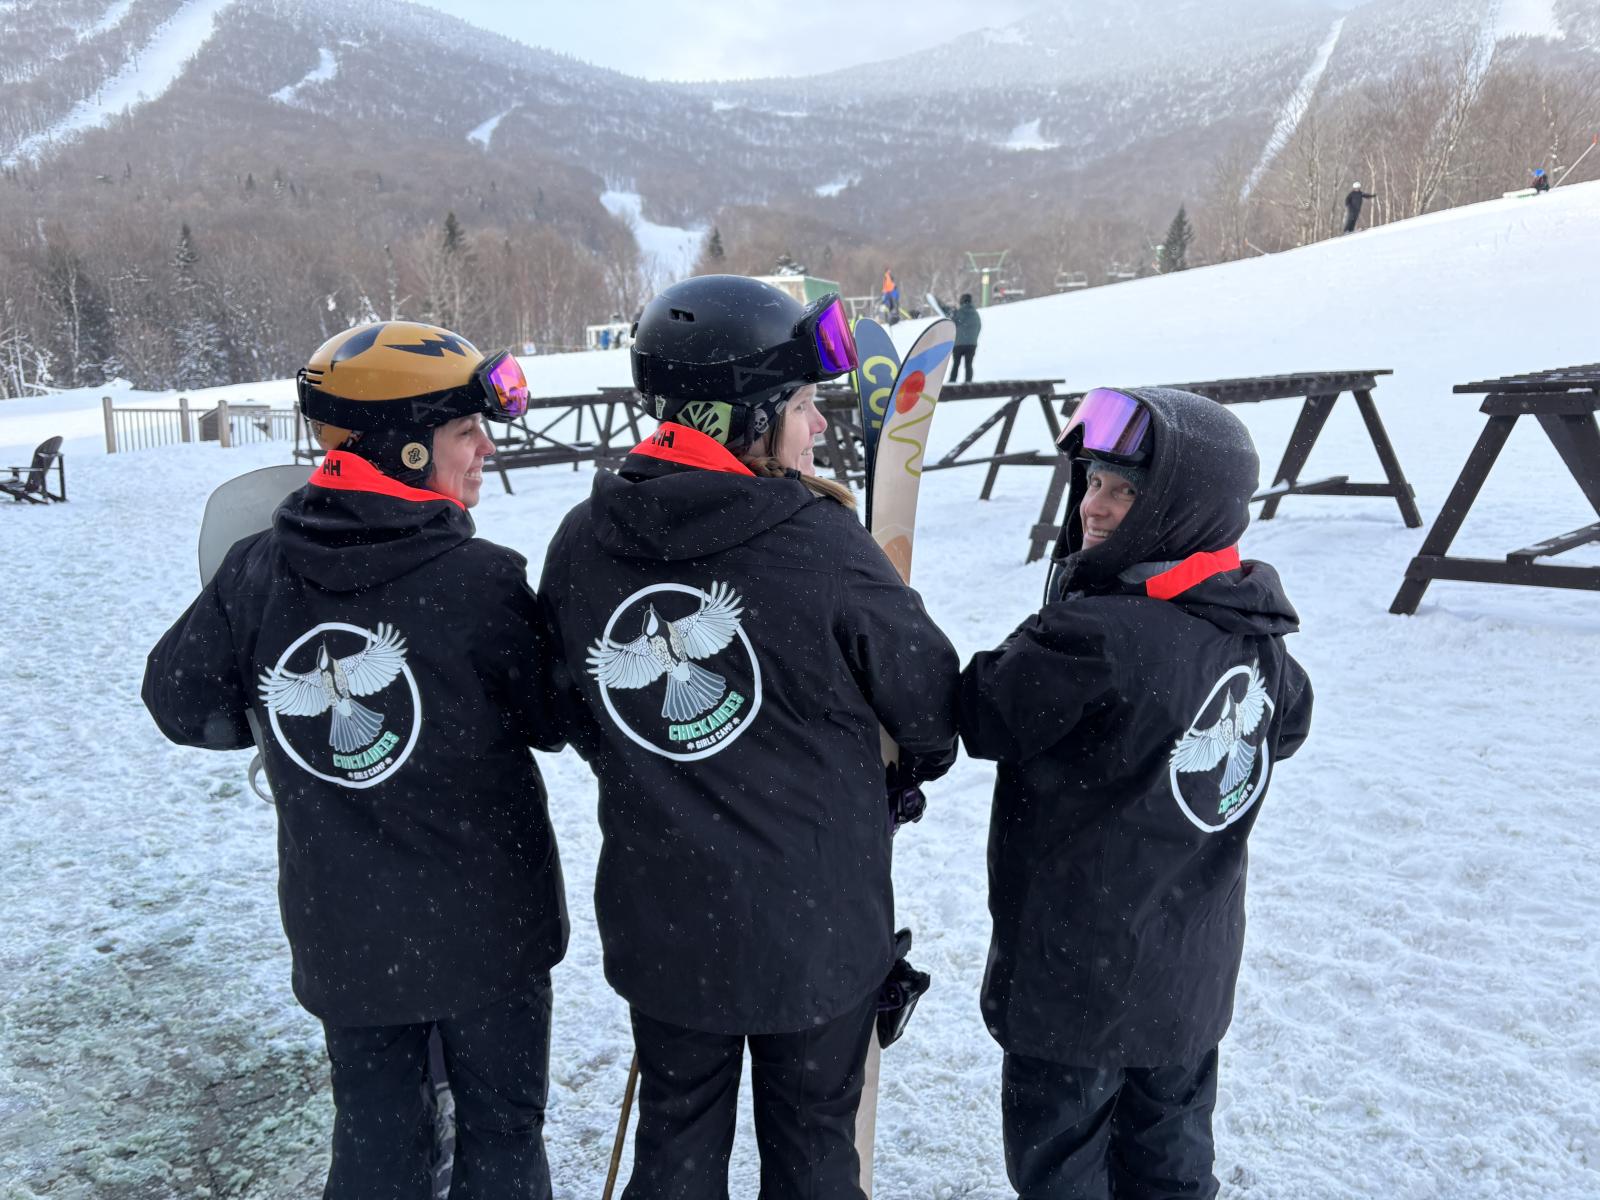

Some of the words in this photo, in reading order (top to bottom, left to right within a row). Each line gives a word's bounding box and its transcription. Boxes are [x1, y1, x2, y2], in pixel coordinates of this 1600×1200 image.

[323, 458, 341, 477] HH
[668, 690, 745, 741] CHICKADEES
[695, 734, 717, 750] GIRLS
[715, 721, 734, 740] CAMP
[367, 761, 386, 777] CAMP
